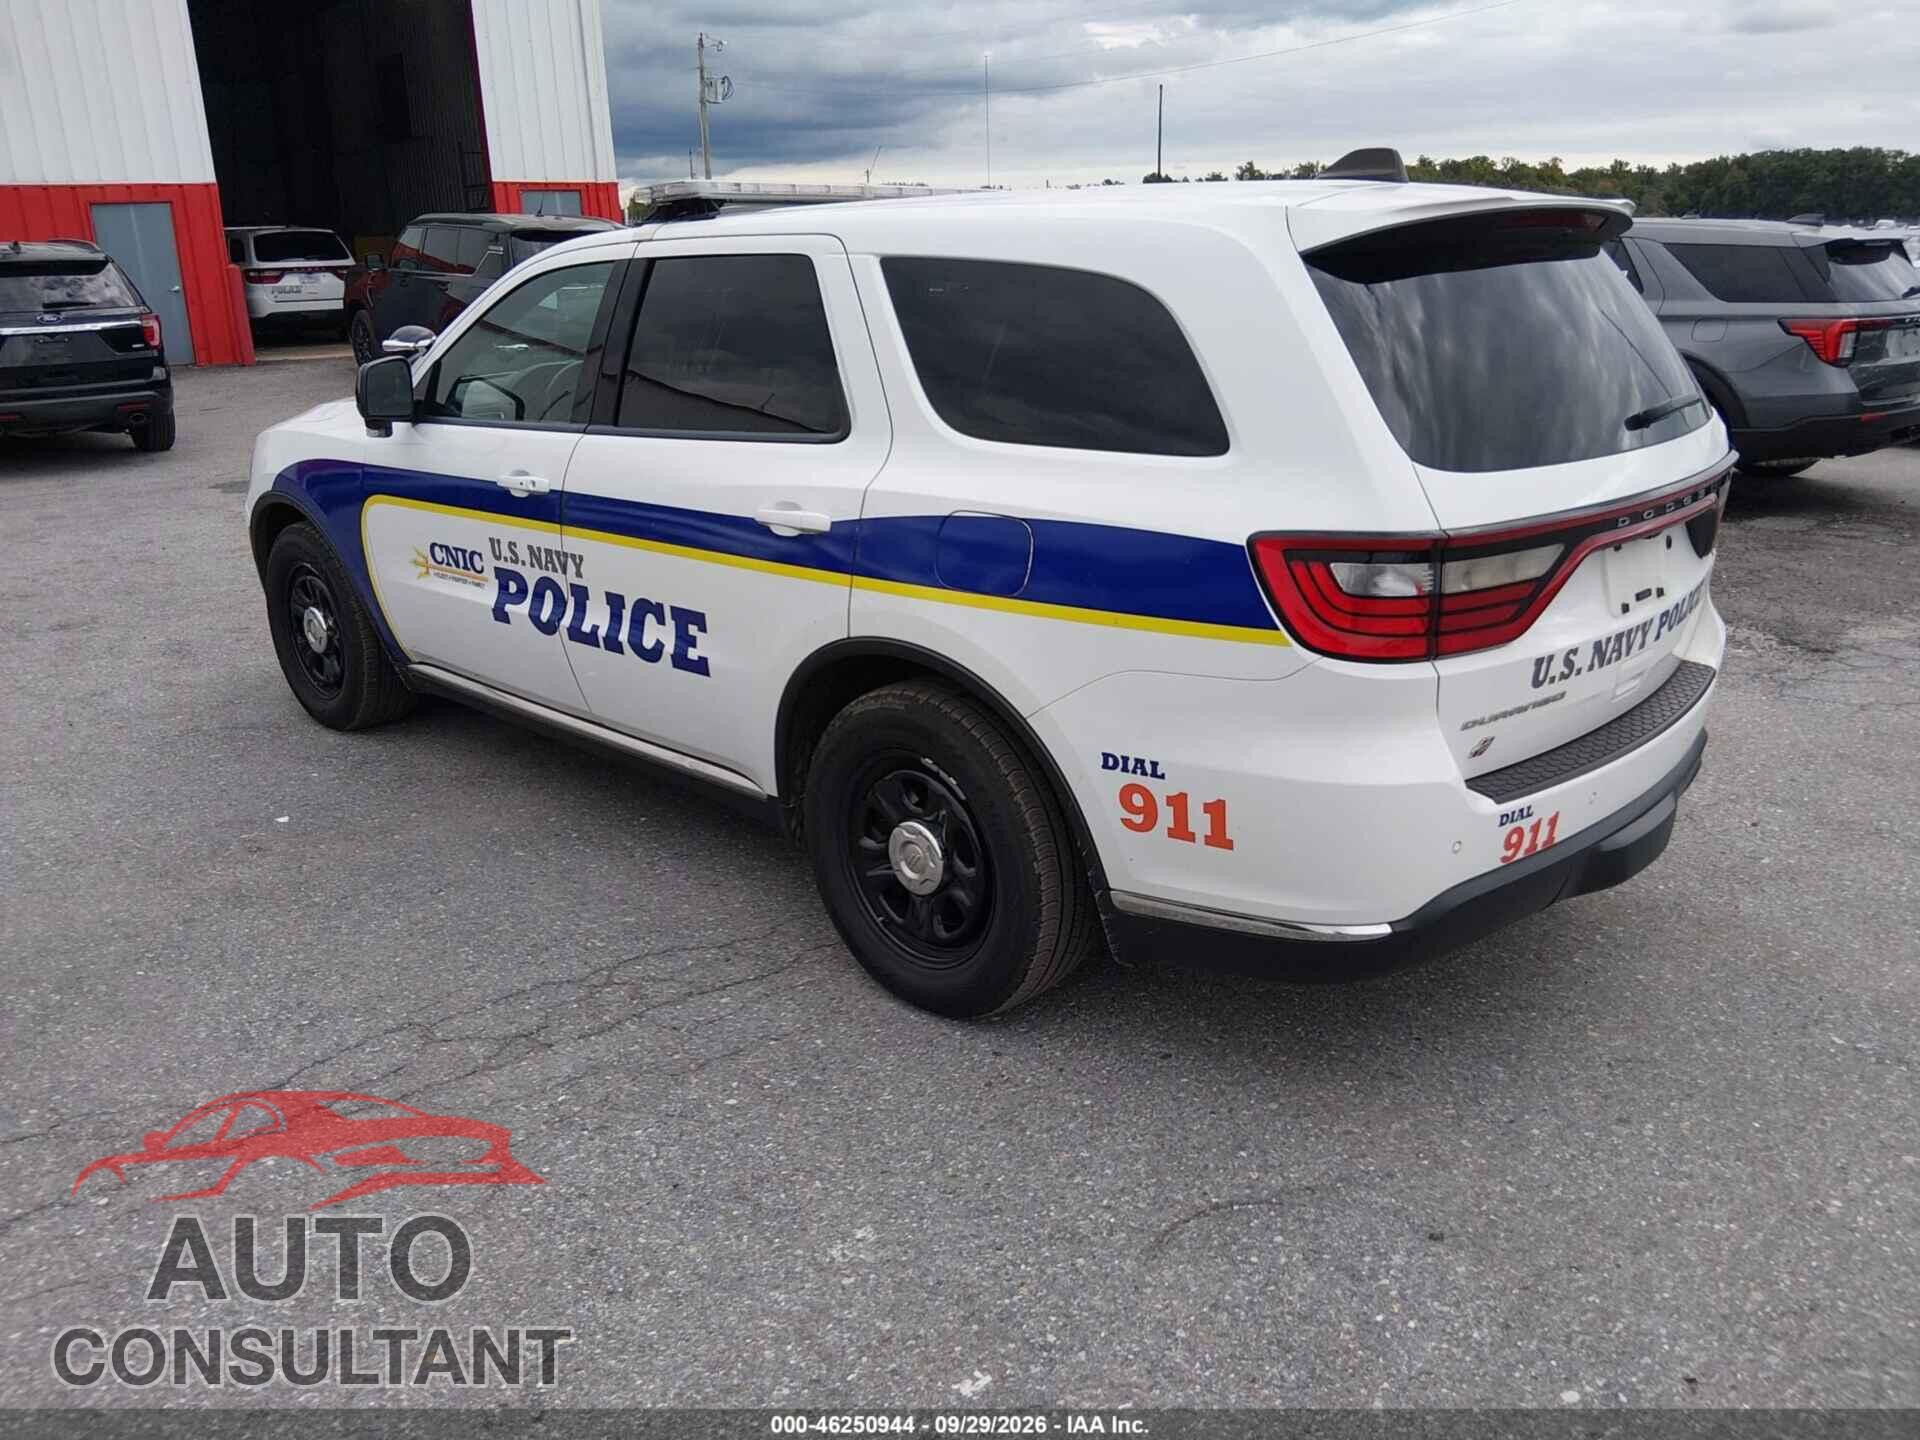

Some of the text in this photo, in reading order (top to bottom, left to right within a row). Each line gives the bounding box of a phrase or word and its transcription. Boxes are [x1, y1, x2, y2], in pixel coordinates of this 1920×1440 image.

[429, 541, 485, 574] CNIC
[489, 536, 584, 578] U.S. NAVY
[491, 566, 712, 678] POLICE
[1531, 577, 1705, 689] U.S. NAVY POLIC
[1101, 752, 1165, 780] DIAL
[1118, 782, 1234, 852] 911
[1498, 804, 1534, 827] DIAL
[1500, 811, 1560, 864] 911
